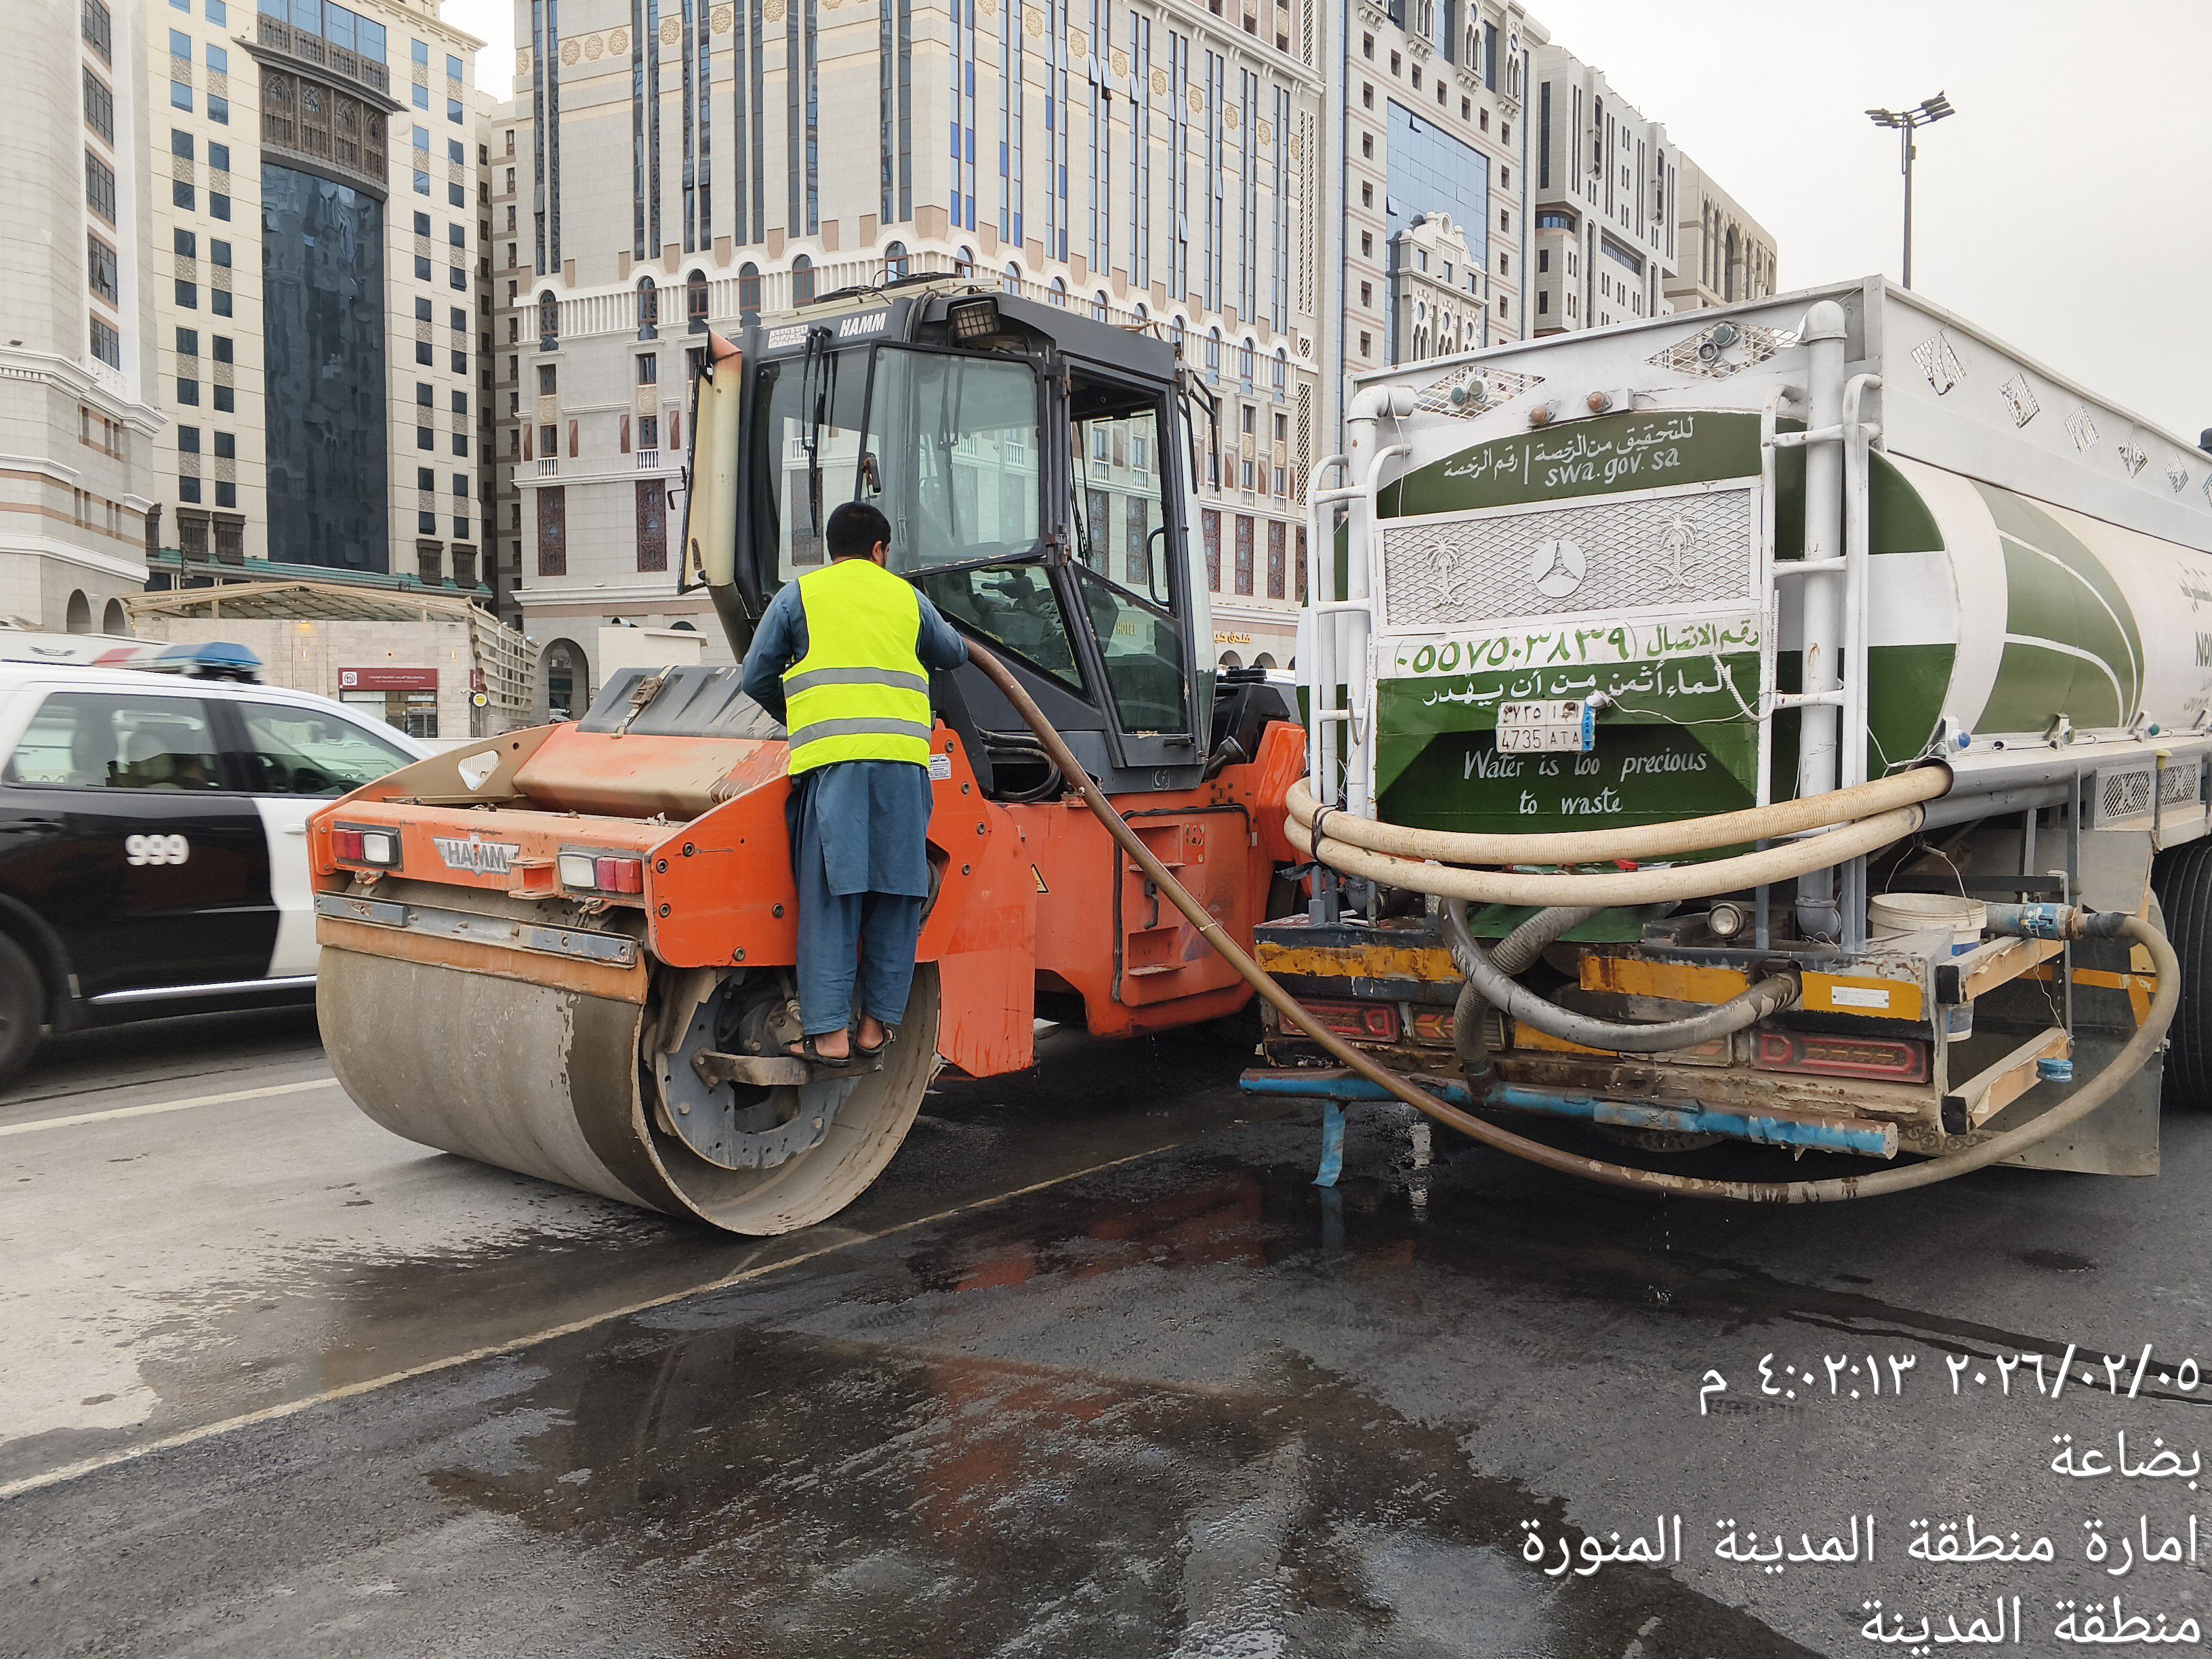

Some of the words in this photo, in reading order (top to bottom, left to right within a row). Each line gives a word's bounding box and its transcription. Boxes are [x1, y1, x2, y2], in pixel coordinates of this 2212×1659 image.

[839, 312, 886, 337] HAMM
[1534, 433, 1586, 464] الرخصة
[1586, 441, 1612, 458] من
[1617, 415, 1694, 455] للتحقيق
[1444, 448, 1492, 478] الرخصة
[1494, 445, 1518, 480] رقم
[1116, 621, 1136, 636] HOTEL
[1647, 623, 1717, 657] الاتصال
[1720, 619, 1760, 653] رقم
[1422, 681, 1502, 707] يهدر
[1511, 669, 1542, 698] أن
[1551, 674, 1597, 695] من
[1502, 729, 1541, 750] 4735
[1464, 747, 1524, 779] Water
[1538, 754, 1559, 777] is
[1620, 747, 1707, 782] precious
[1519, 790, 1538, 815] to
[1561, 787, 1623, 815] waste
[125, 834, 190, 865] 999
[447, 842, 508, 869] HAMM
